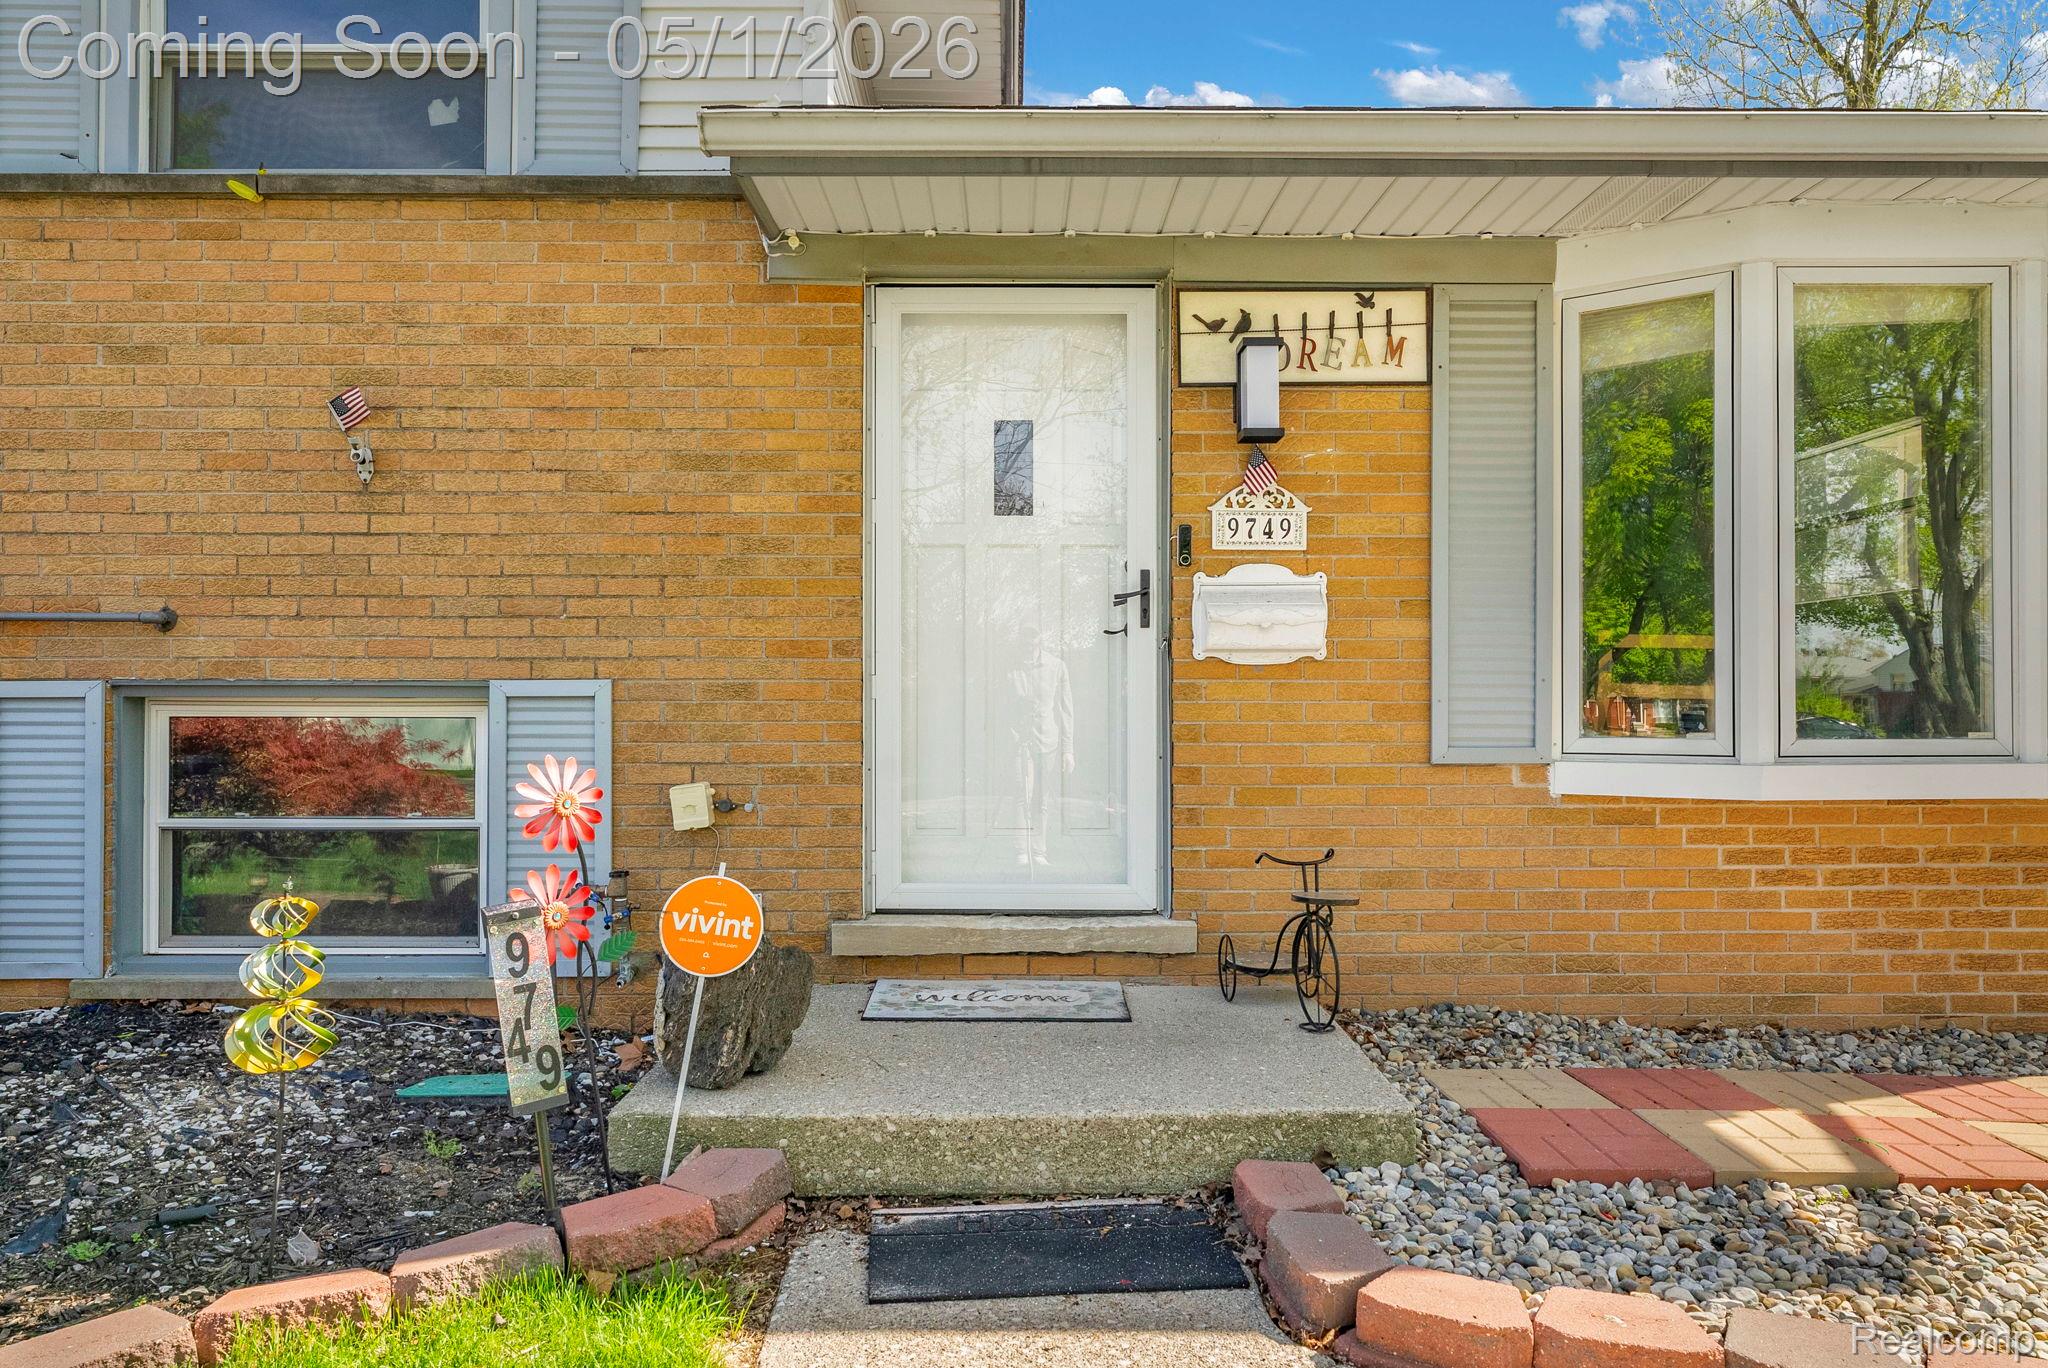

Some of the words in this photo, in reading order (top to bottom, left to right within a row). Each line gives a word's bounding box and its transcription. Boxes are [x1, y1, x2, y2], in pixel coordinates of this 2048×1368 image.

[1227, 517, 1292, 540] 9749
[672, 907, 754, 940] vivint
[915, 989, 1076, 1003] welcome
[505, 931, 562, 1091] 9749
